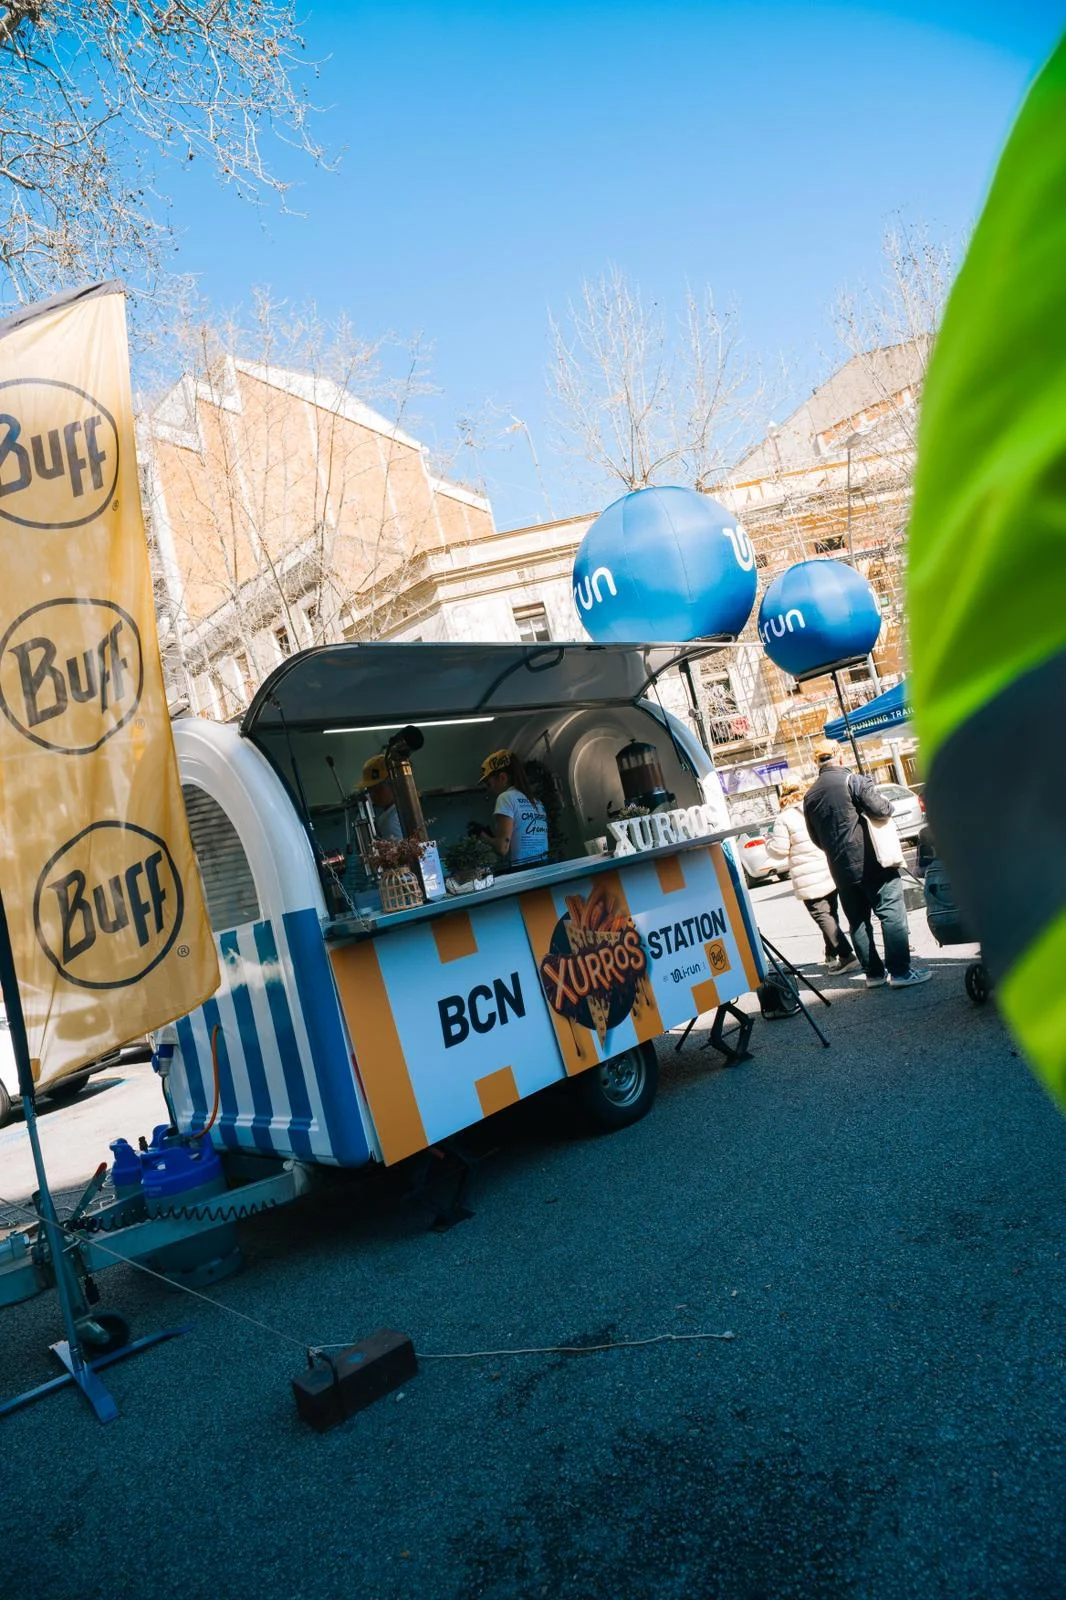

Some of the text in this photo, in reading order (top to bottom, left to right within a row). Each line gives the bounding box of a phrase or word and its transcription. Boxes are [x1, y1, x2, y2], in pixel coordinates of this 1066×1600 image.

[850, 715, 888, 732] RUNNING
[437, 908, 727, 1049] BCN XURROS STATION
